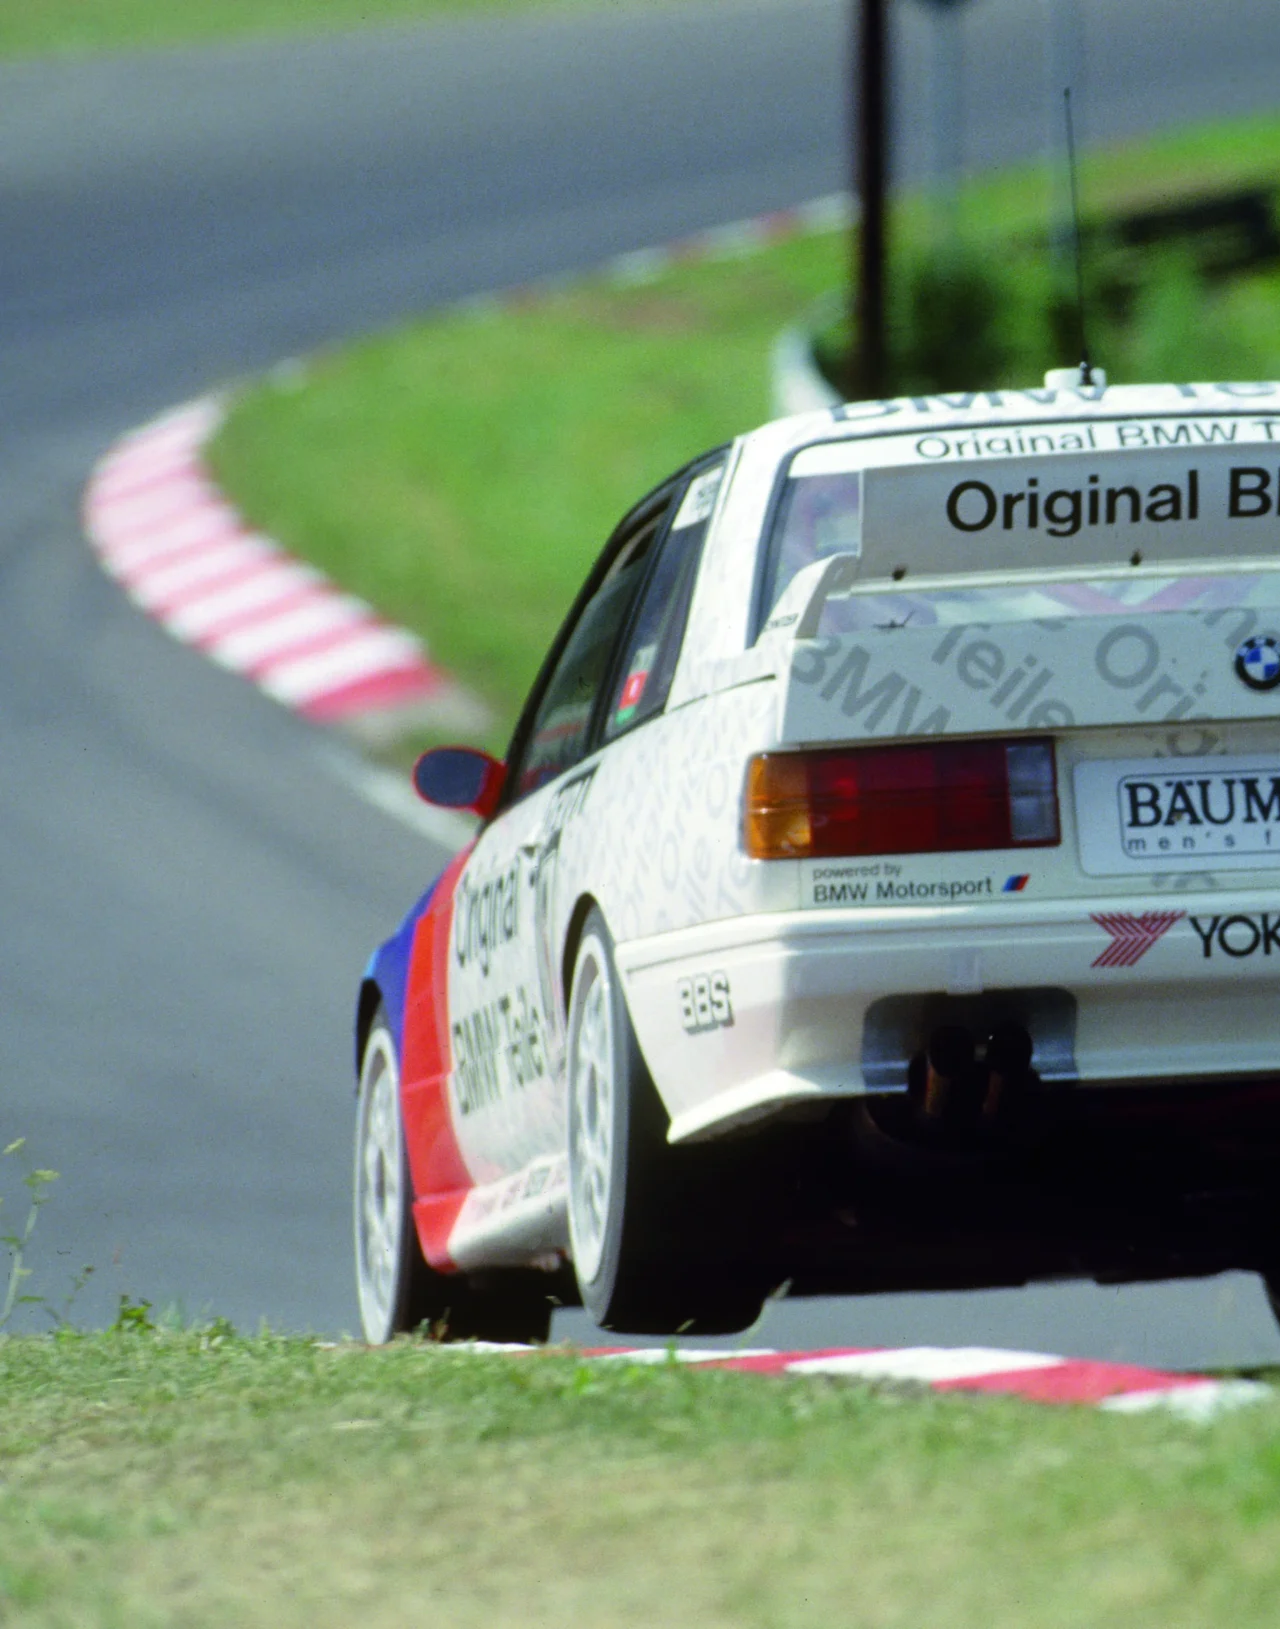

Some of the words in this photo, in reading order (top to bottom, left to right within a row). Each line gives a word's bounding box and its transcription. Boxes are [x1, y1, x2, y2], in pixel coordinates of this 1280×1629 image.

[914, 425, 1098, 460] Original
[1116, 421, 1239, 448] BMW
[944, 468, 1199, 538] Original
[1127, 829, 1236, 851] men's
[812, 863, 881, 881] powered
[883, 862, 902, 877] by
[812, 882, 868, 903] BMW
[876, 876, 993, 900] Motorsport
[676, 968, 736, 1036] BBS
